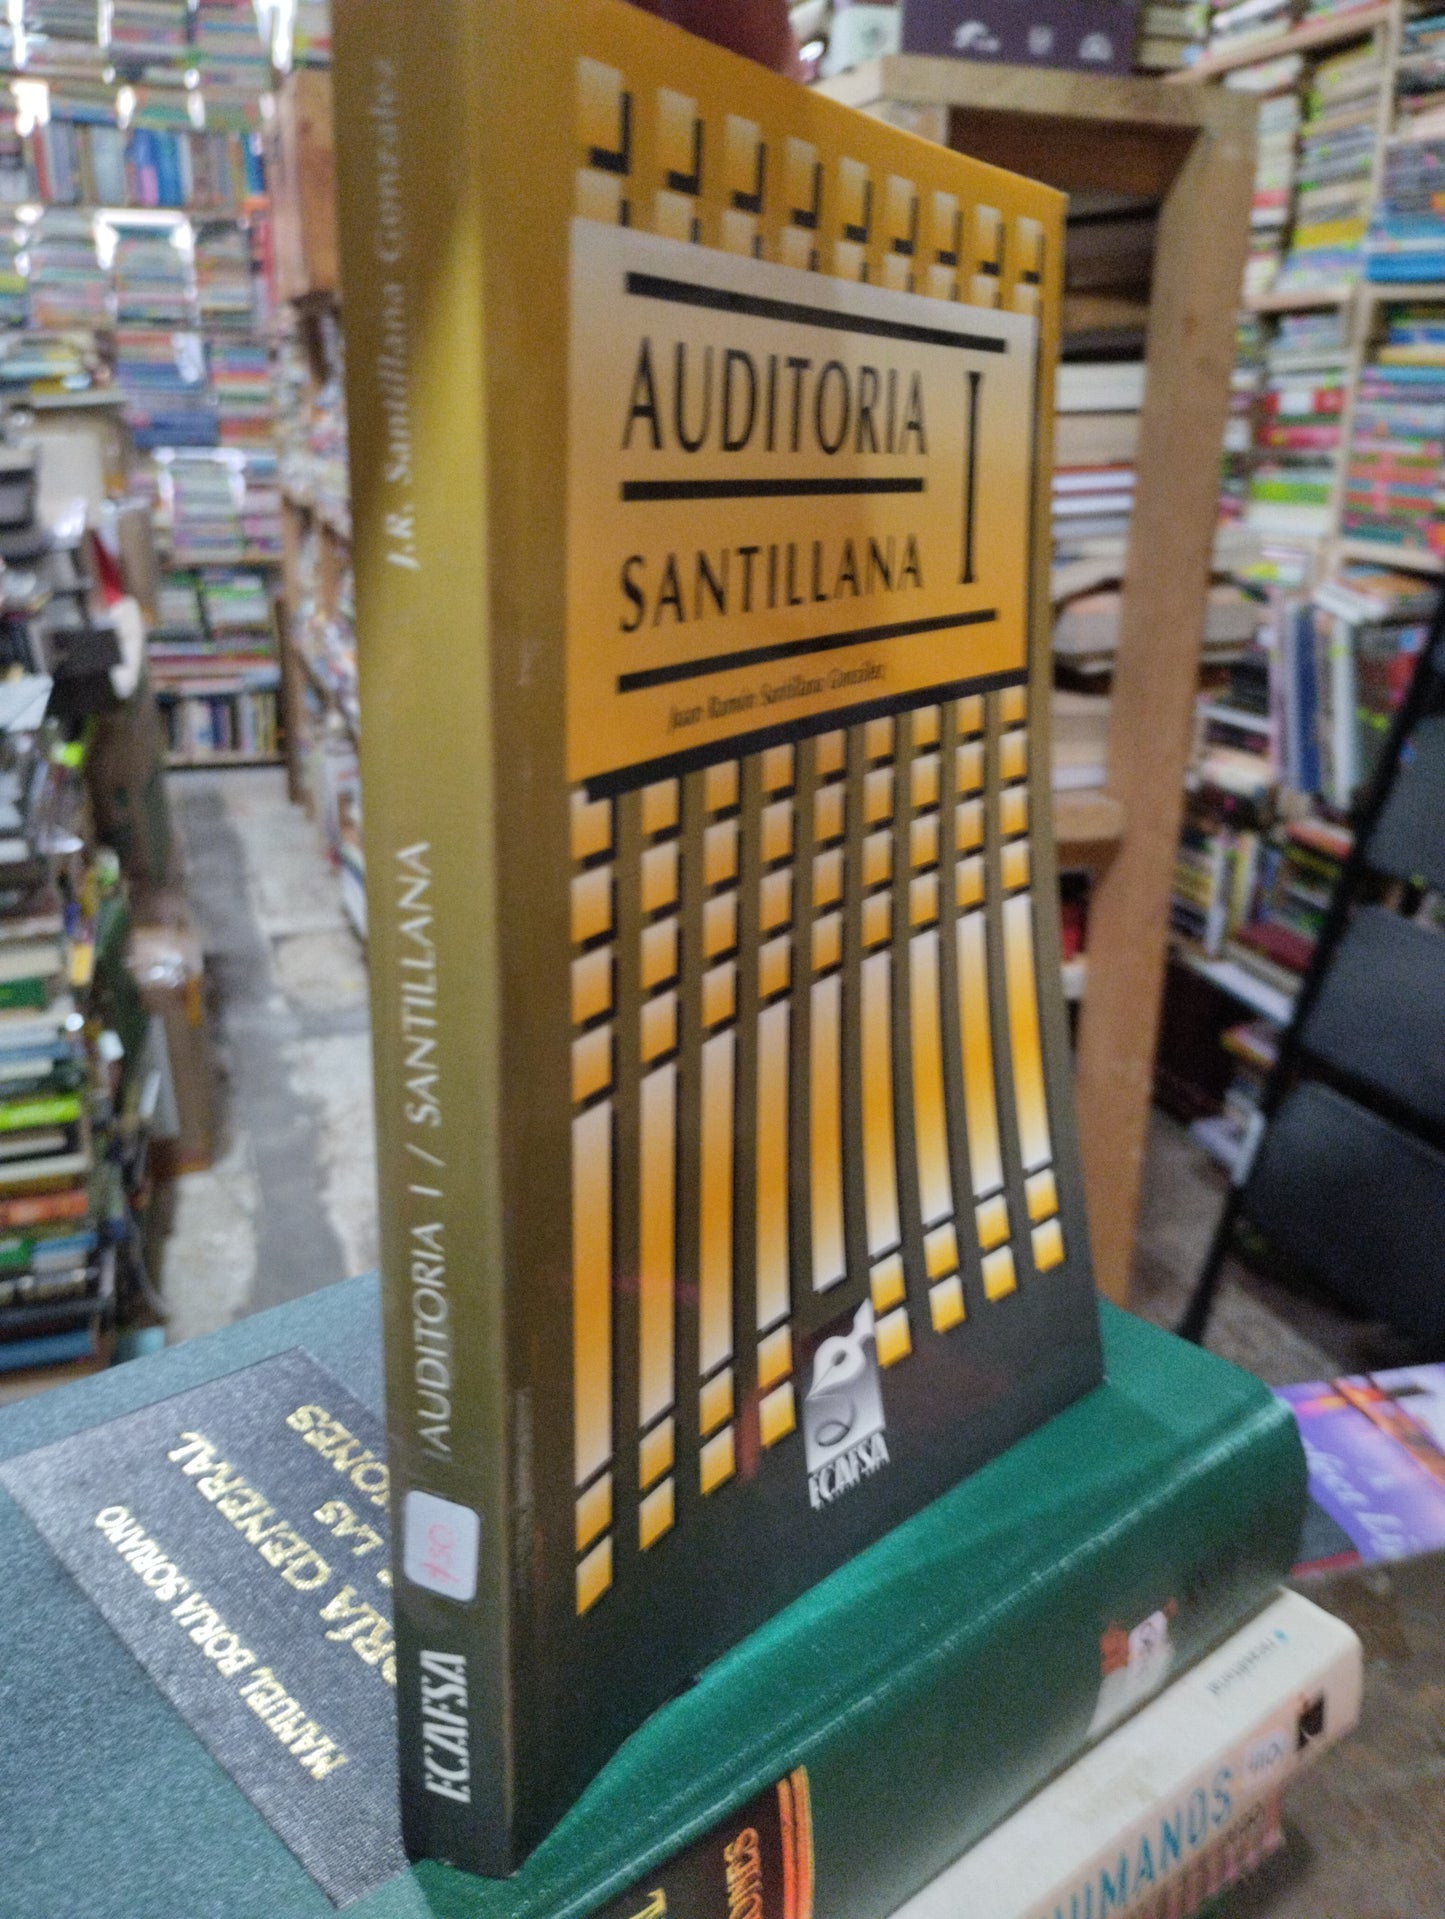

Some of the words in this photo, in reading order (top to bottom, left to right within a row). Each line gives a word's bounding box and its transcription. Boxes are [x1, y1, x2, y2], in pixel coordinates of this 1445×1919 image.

[377, 282, 413, 486] Santillana
[621, 336, 929, 456] AUDITORIA
[958, 369, 983, 586] I
[619, 533, 924, 634] SANTILLANA
[667, 702, 703, 735] Juan
[760, 674, 826, 706] Santillana
[395, 840, 442, 1129] SANTILLANA
[408, 1221, 452, 1454] AUDITORIA
[95, 1504, 191, 1603] SORIANO
[168, 1431, 332, 1592] GENERAL
[312, 1500, 384, 1556] LAS
[170, 1592, 257, 1678] BORJA
[238, 1666, 349, 1781] MANUEL
